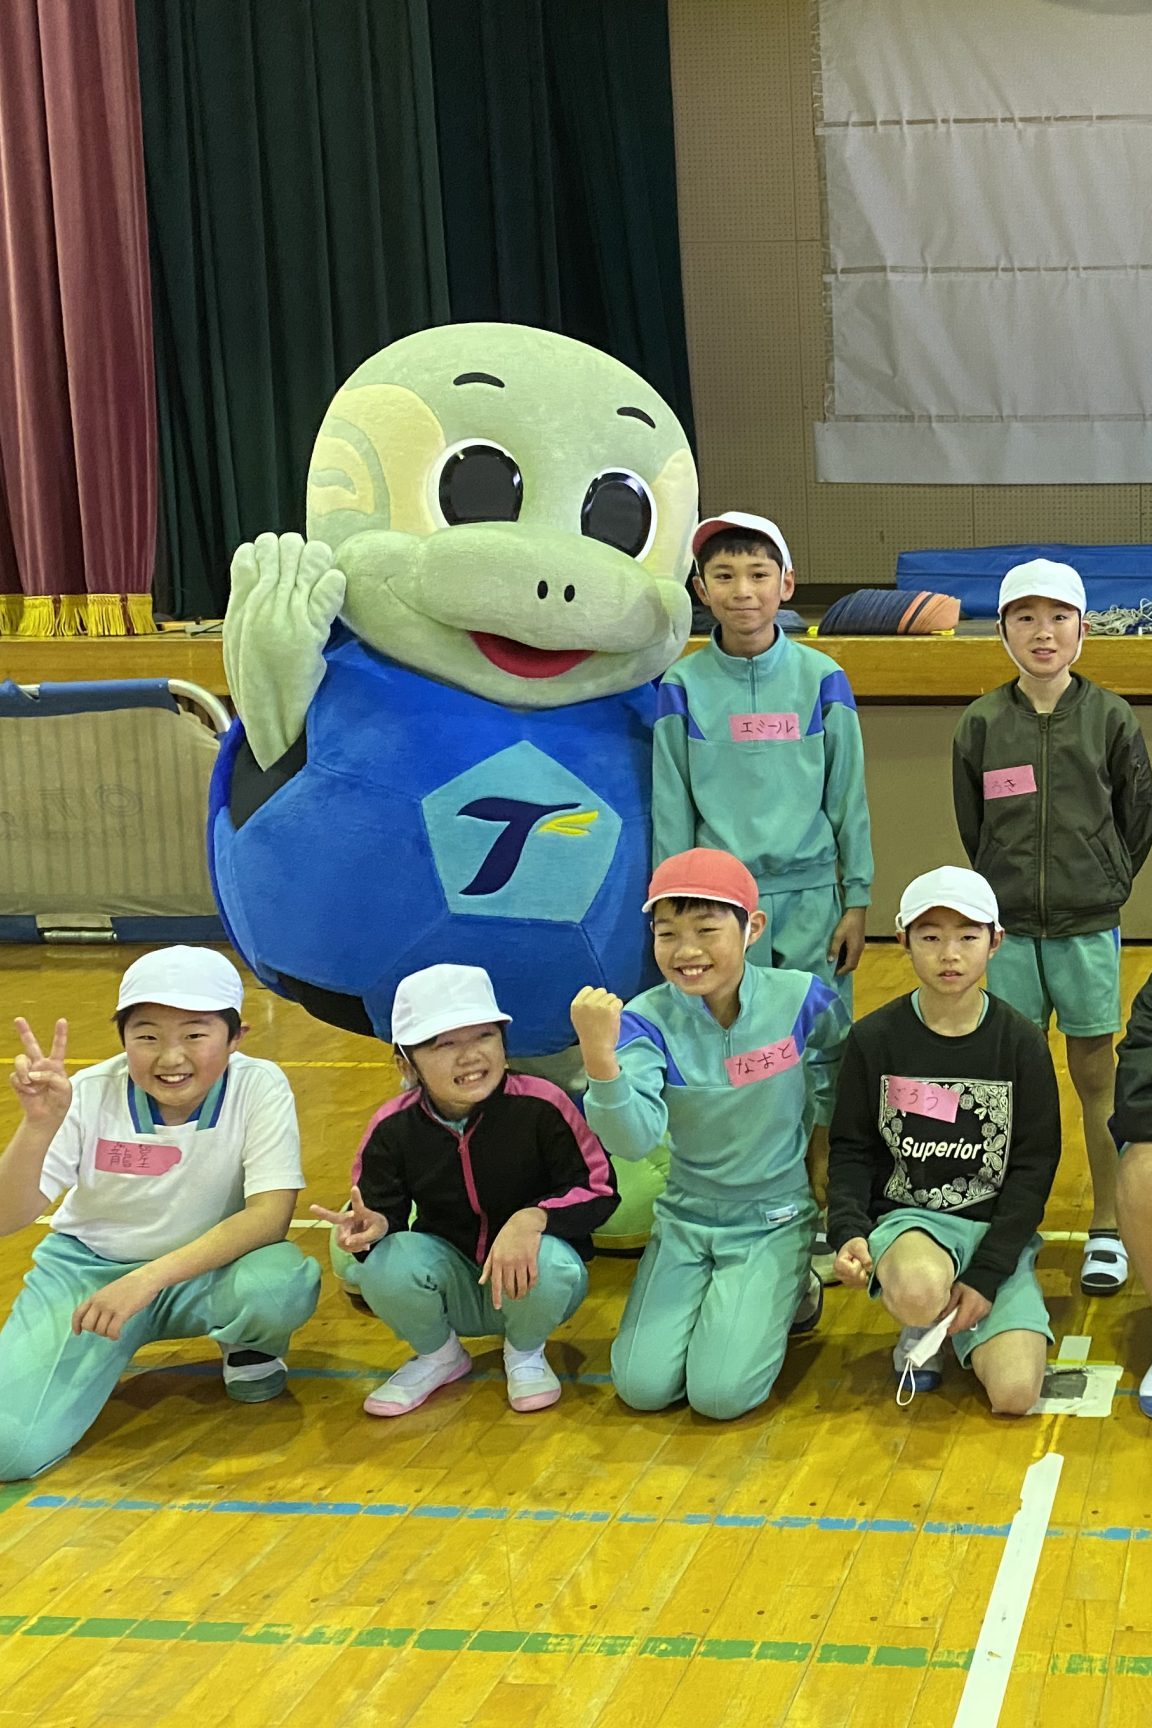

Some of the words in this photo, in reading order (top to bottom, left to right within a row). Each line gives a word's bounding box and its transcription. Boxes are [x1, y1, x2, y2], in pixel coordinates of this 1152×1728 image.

[740, 719, 795, 735] エミール
[735, 1043, 793, 1075] なおと
[901, 1136, 983, 1163] Superior
